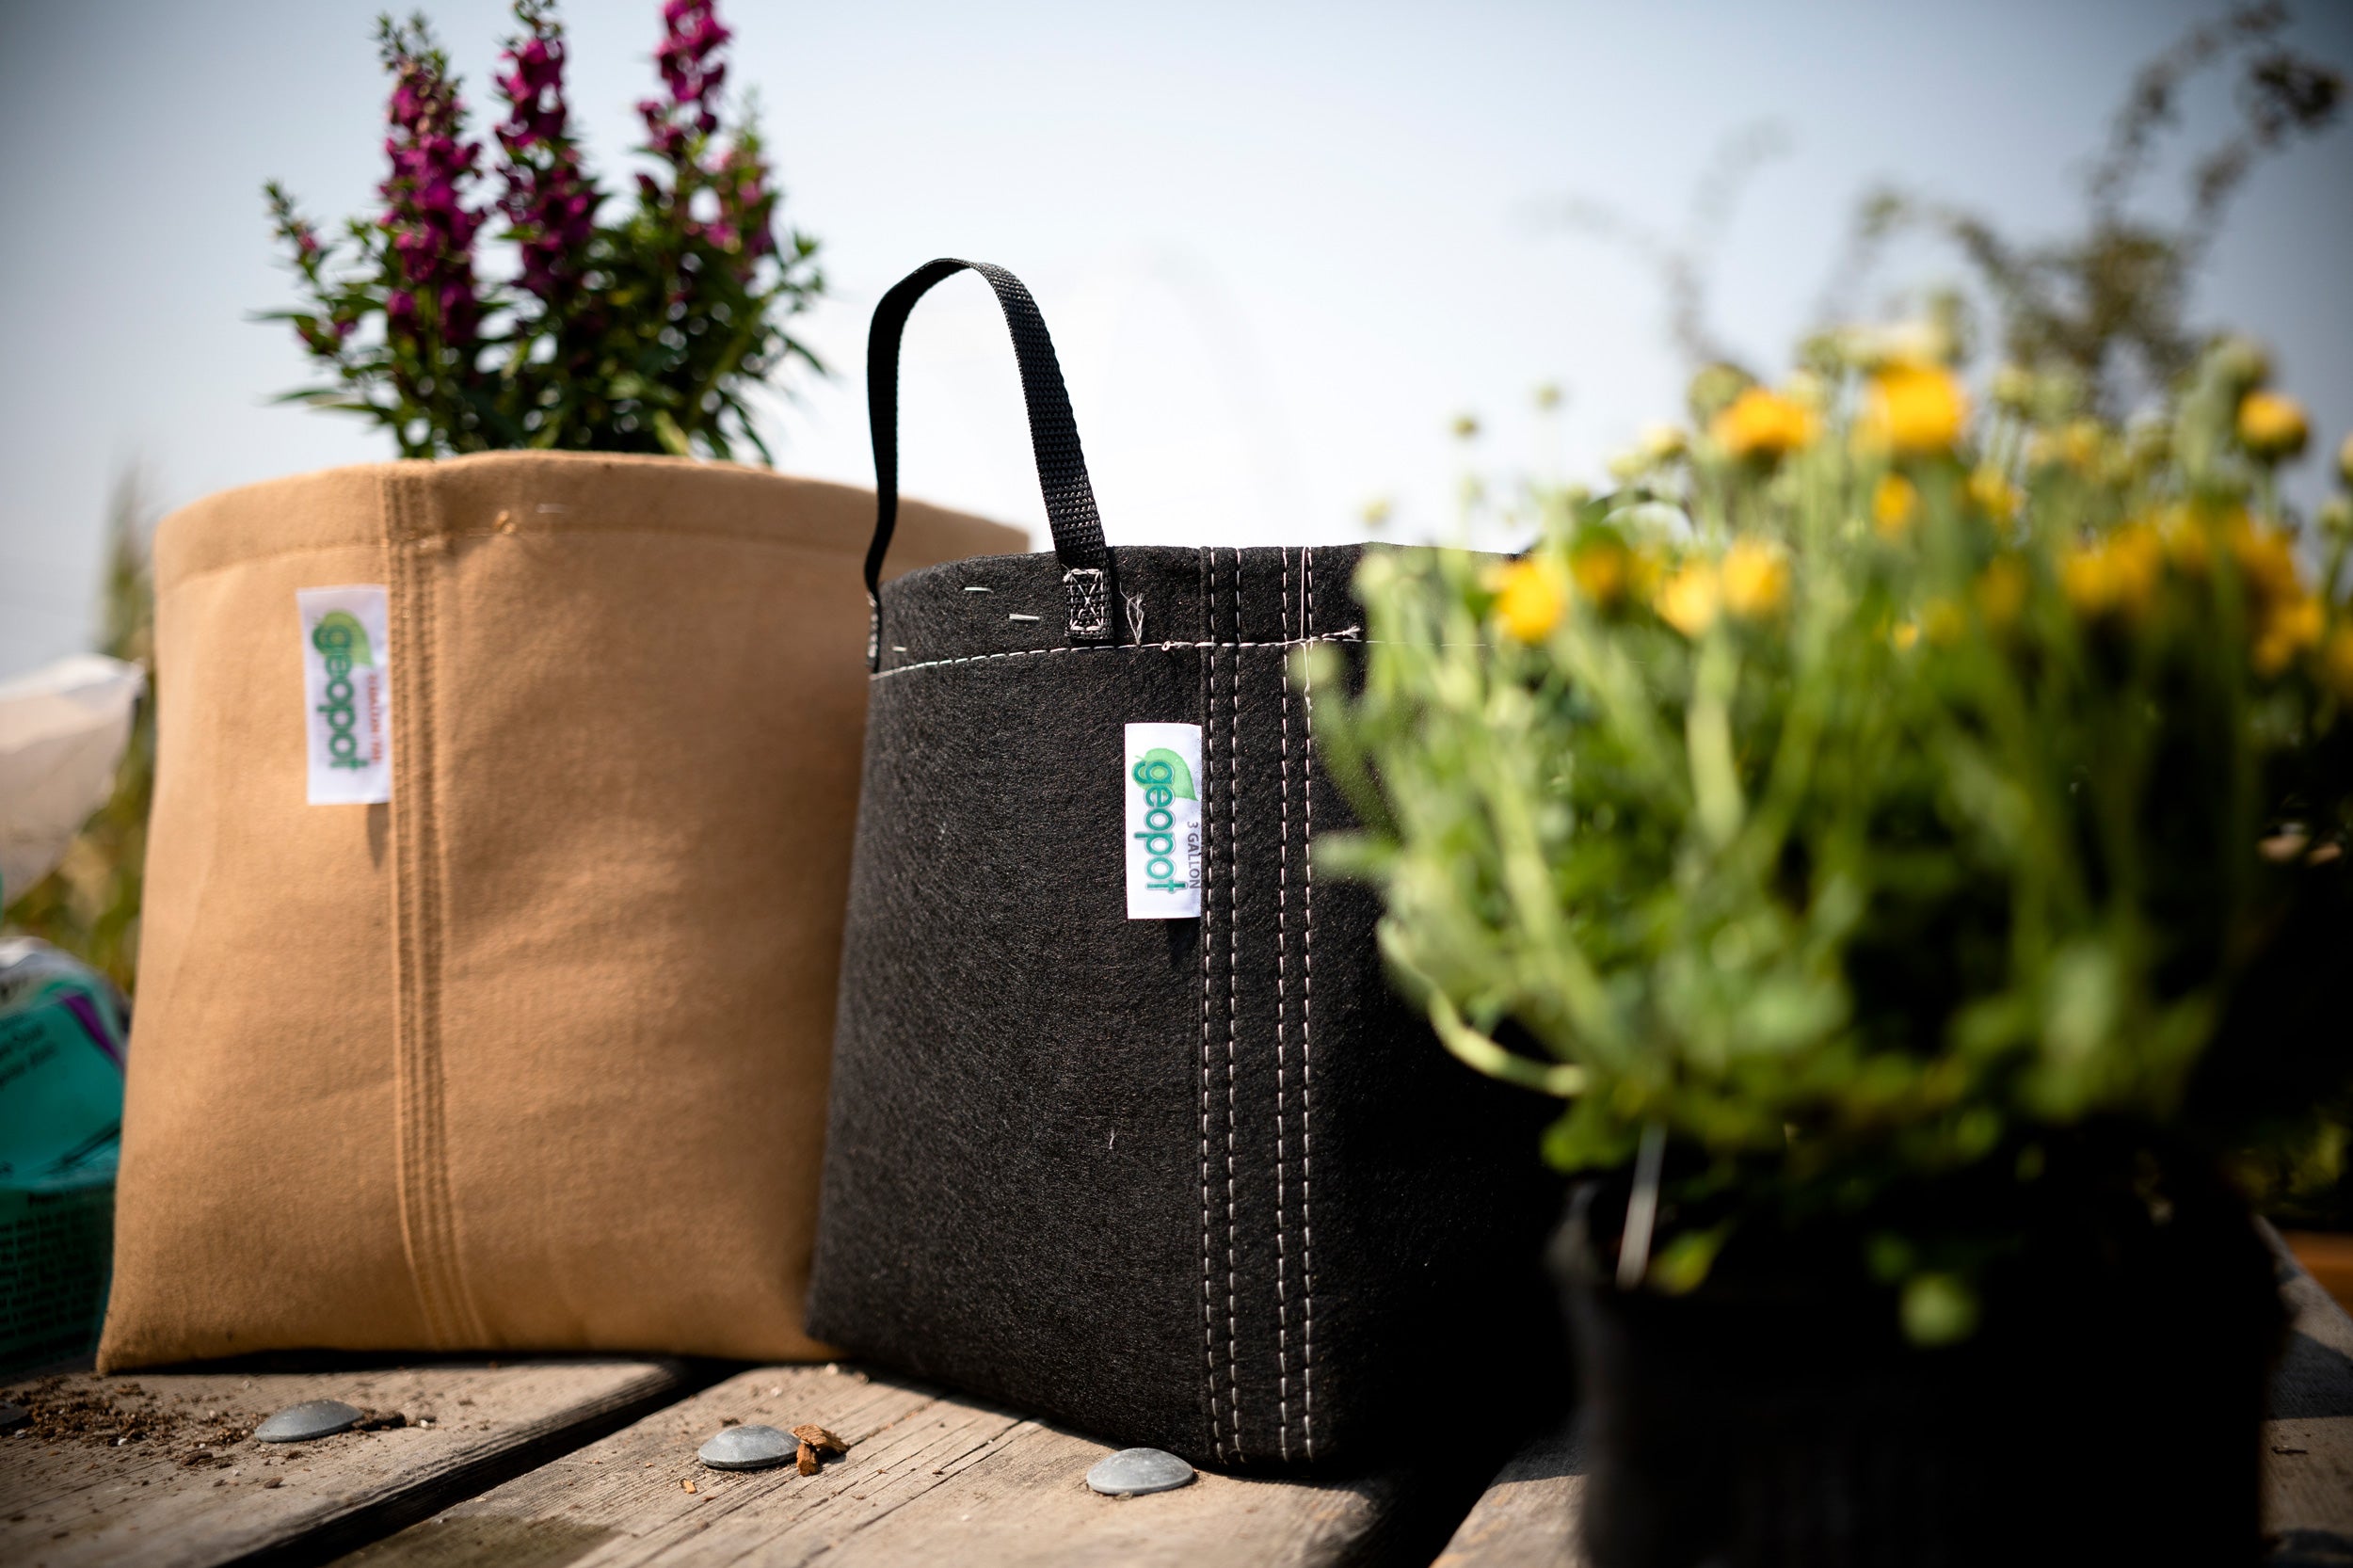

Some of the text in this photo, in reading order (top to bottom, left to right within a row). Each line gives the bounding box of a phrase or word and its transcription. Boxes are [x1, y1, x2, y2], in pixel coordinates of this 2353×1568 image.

[312, 625, 369, 771] geopot
[1133, 760, 1188, 892] geopot
[1188, 832, 1201, 889] GALLON
